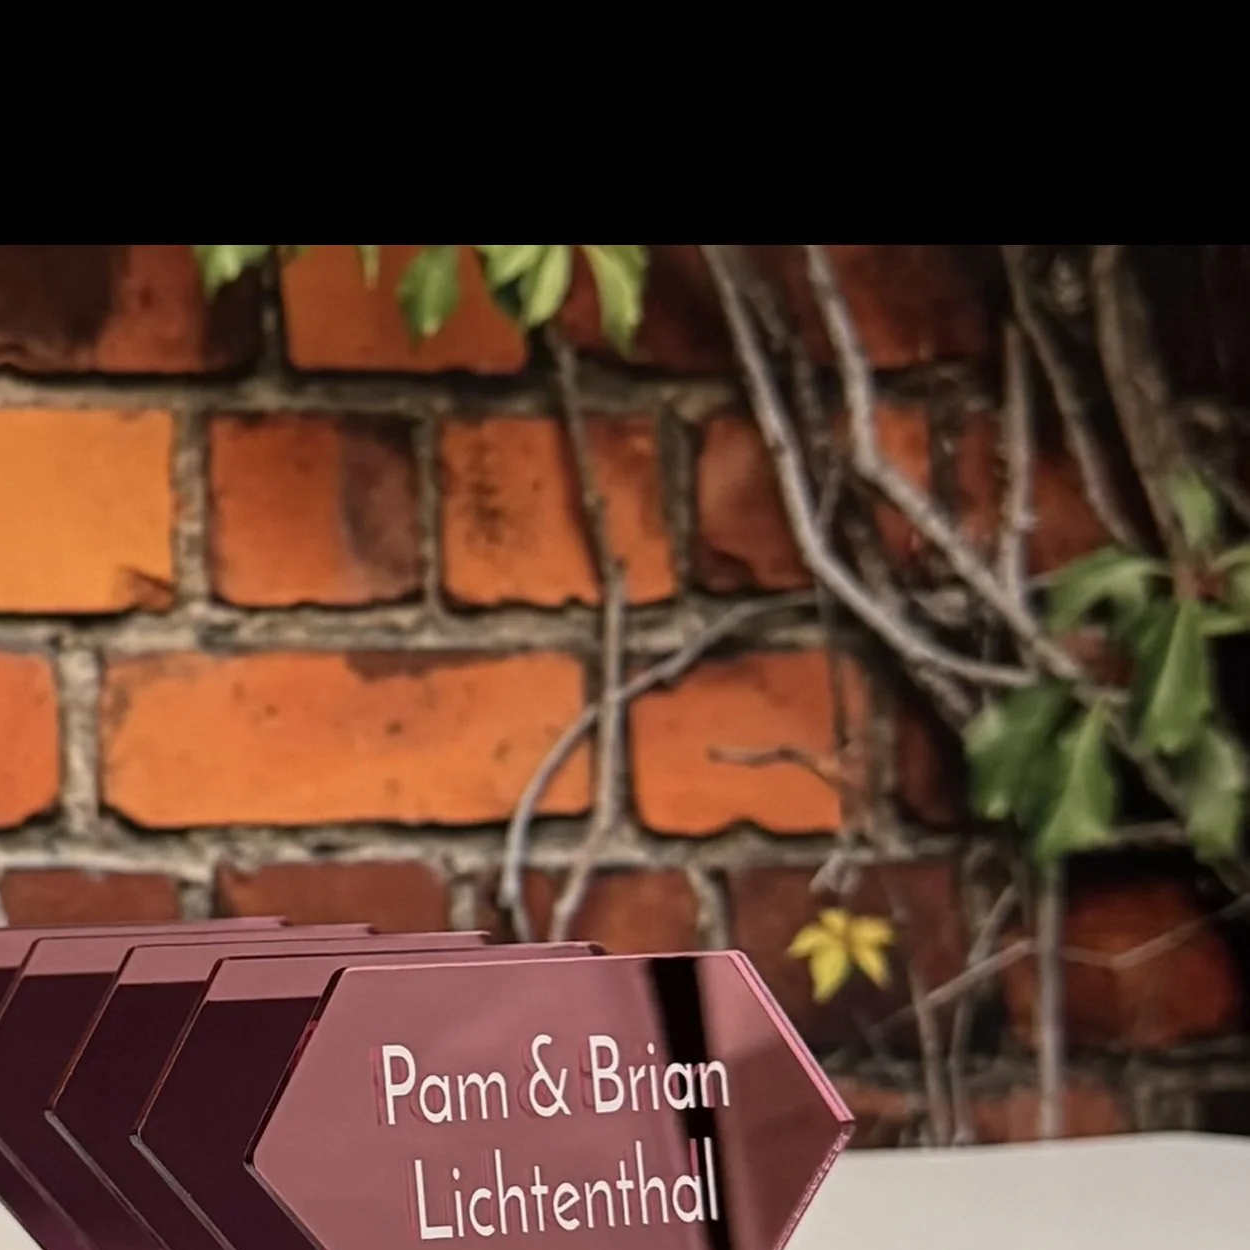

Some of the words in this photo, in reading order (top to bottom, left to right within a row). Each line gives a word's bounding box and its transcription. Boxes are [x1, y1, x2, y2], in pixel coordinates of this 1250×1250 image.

[382, 1045, 508, 1125] Pam
[529, 1034, 571, 1117] &
[589, 1035, 729, 1113] Brian
[414, 1137, 718, 1240] Lichtenthal
